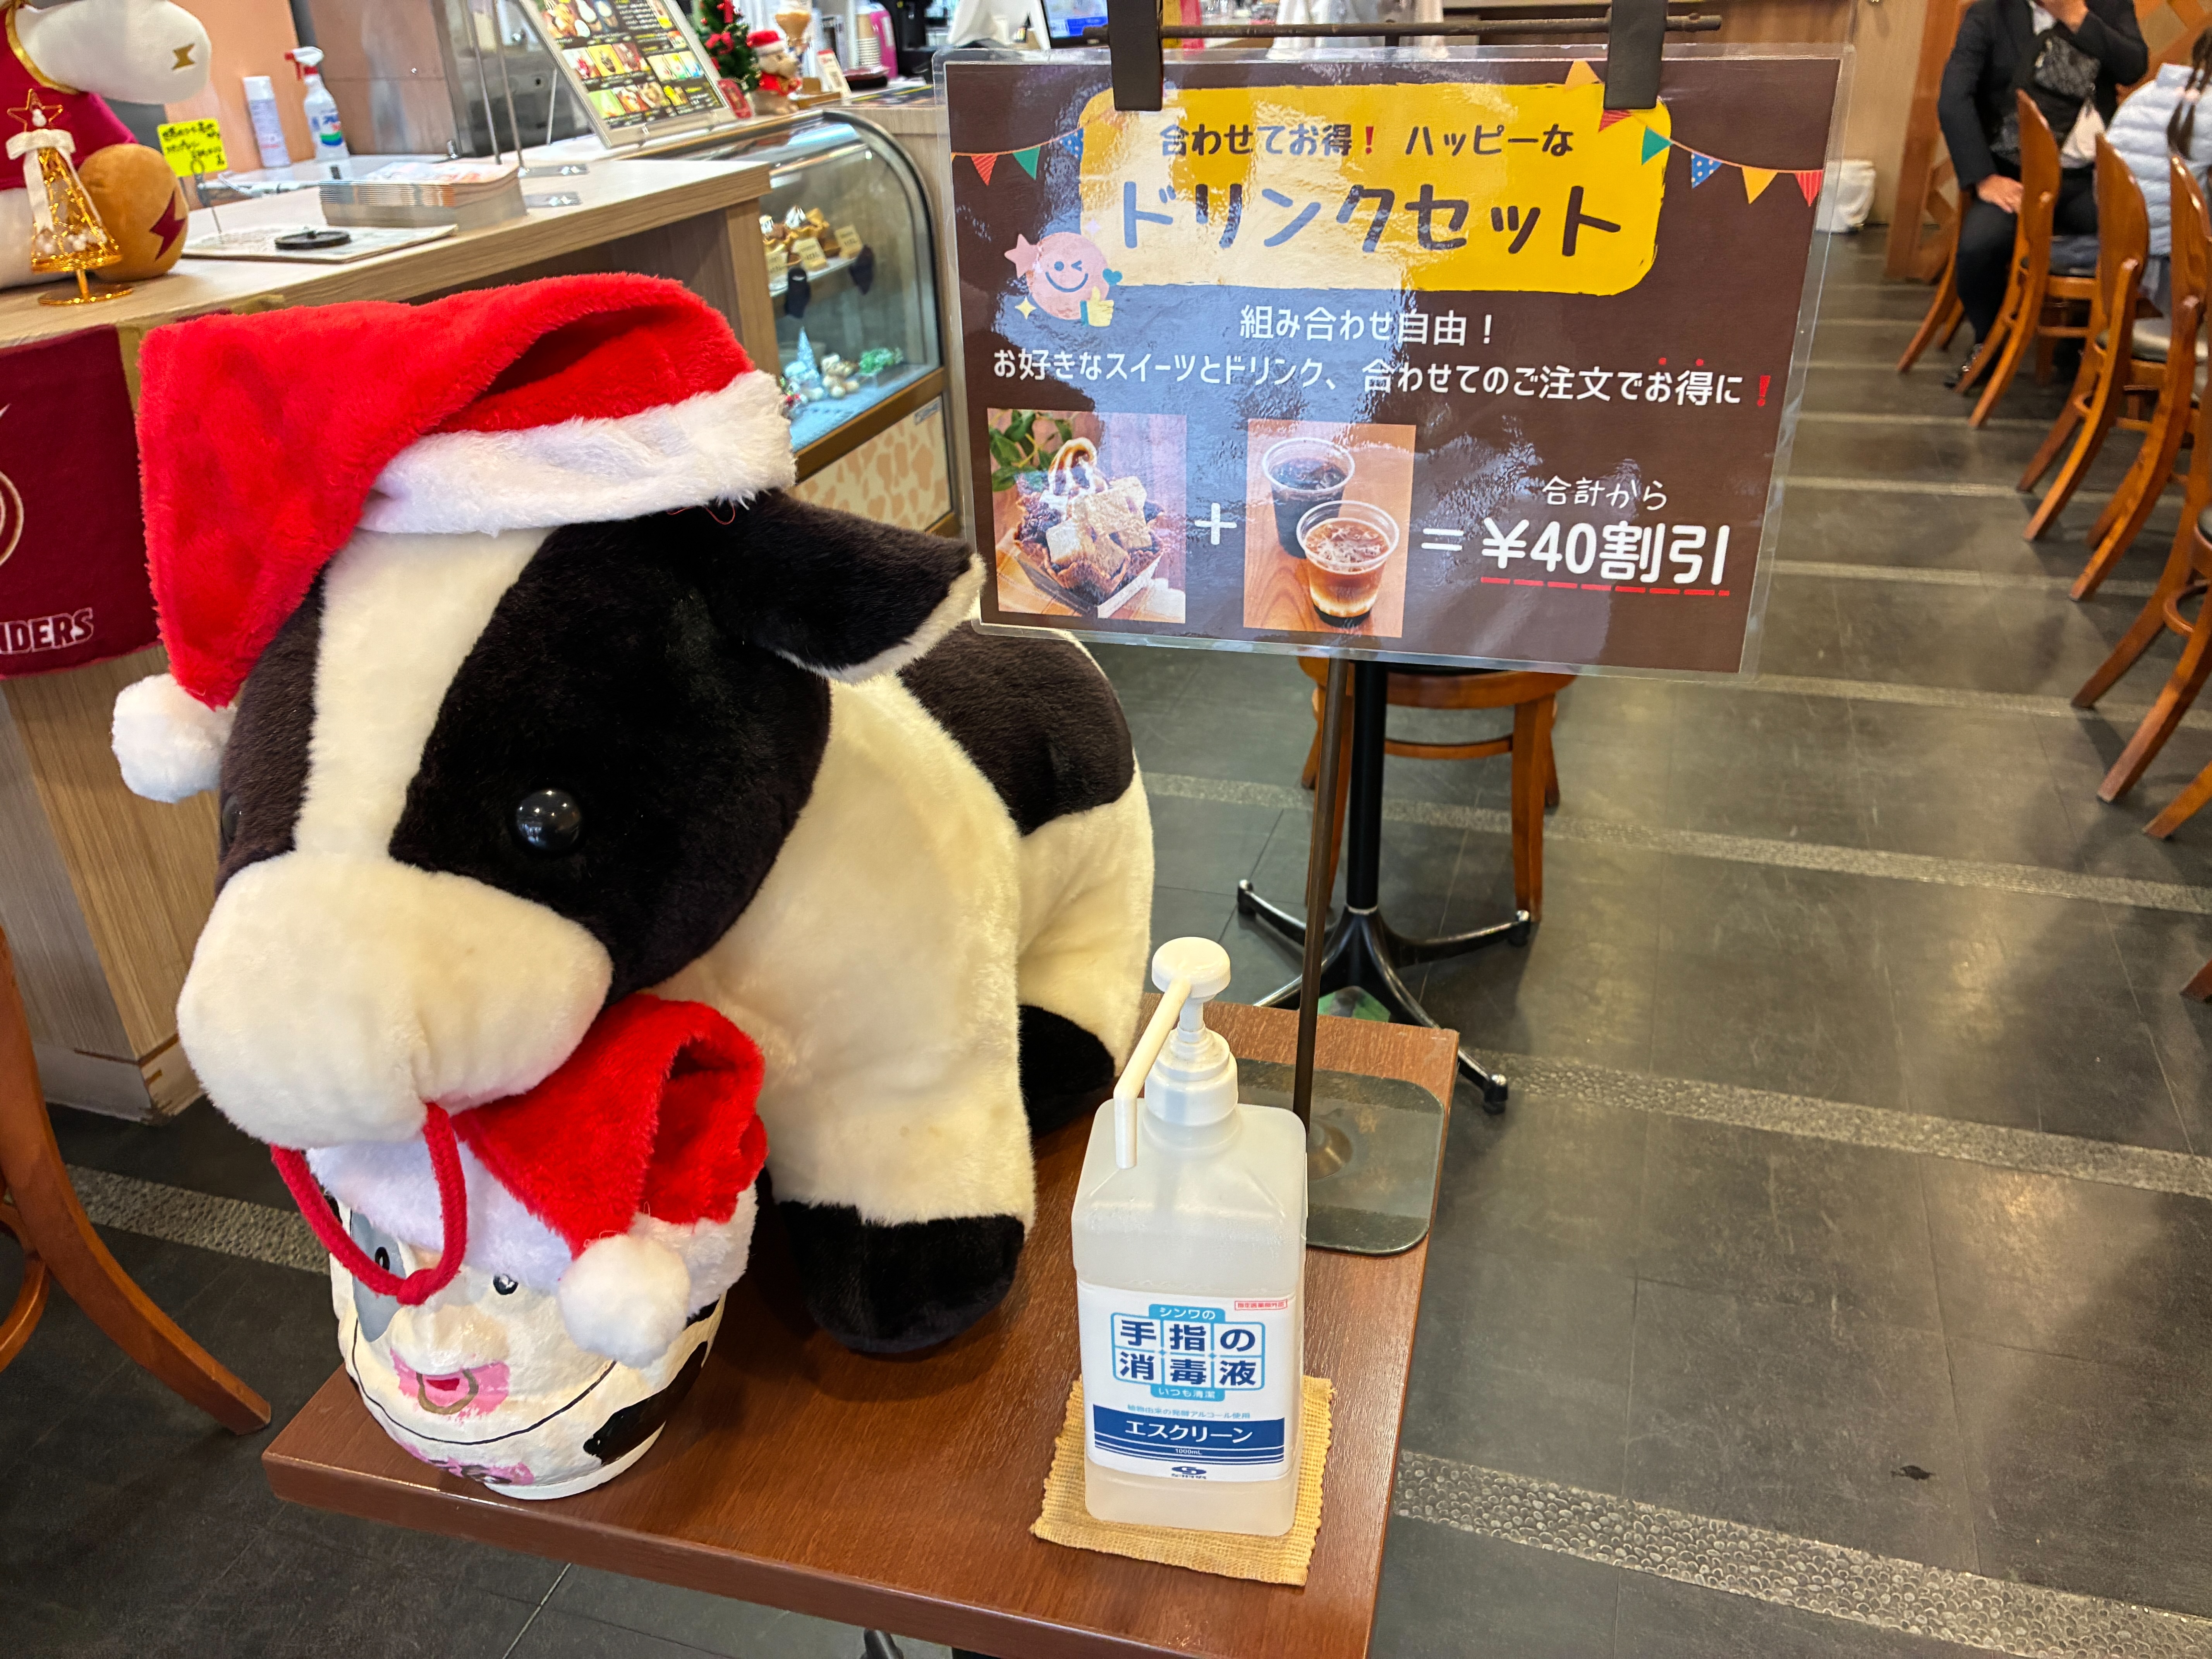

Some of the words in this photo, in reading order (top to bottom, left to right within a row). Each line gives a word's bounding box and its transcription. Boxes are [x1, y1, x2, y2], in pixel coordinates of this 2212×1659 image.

[1405, 123, 1574, 156] ハッピーな
[1123, 180, 1621, 257] ドリンクセット
[1542, 476, 1668, 511] 合計から
[1159, 1307, 1216, 1320] シンワの
[1120, 1320, 1256, 1352] 手指の
[1120, 1351, 1256, 1386] 消毒液
[1125, 1420, 1253, 1444] エスクリーン
